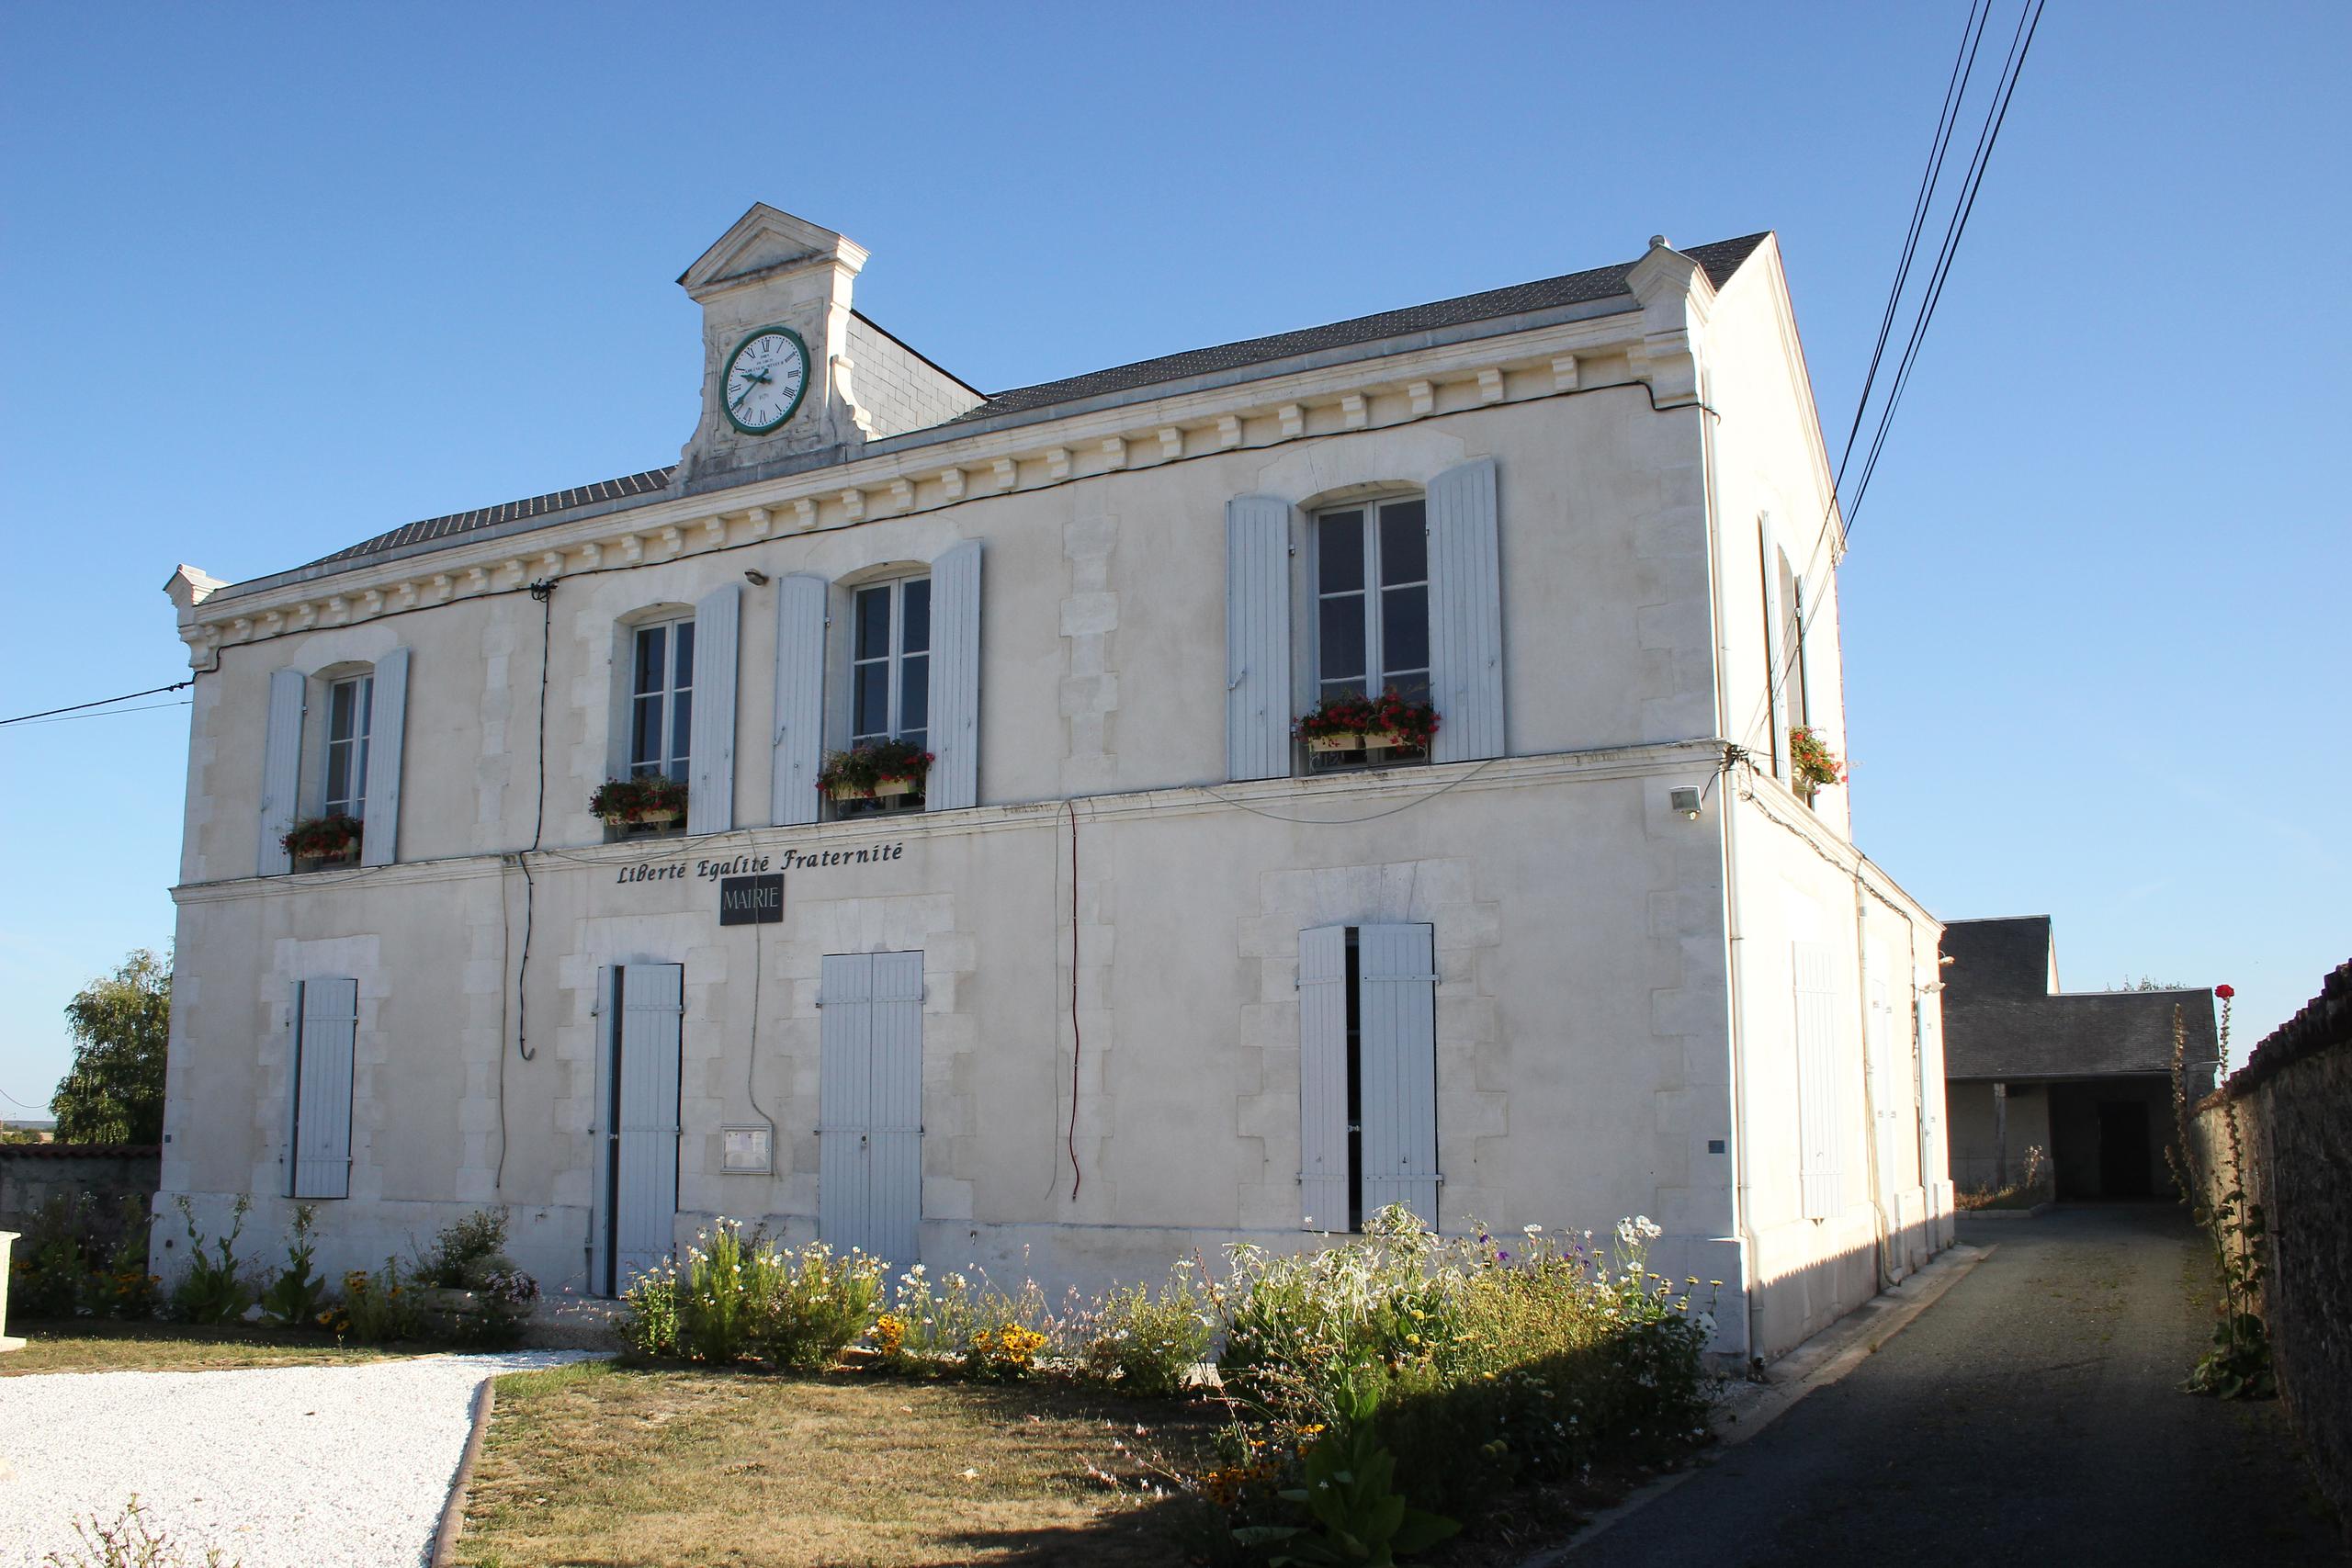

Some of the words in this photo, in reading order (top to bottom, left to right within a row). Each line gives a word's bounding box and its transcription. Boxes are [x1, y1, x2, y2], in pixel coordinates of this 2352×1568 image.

[696, 855, 770, 882] Egalité
[781, 842, 904, 871] Fraternité
[723, 886, 779, 911] MAIRIE
